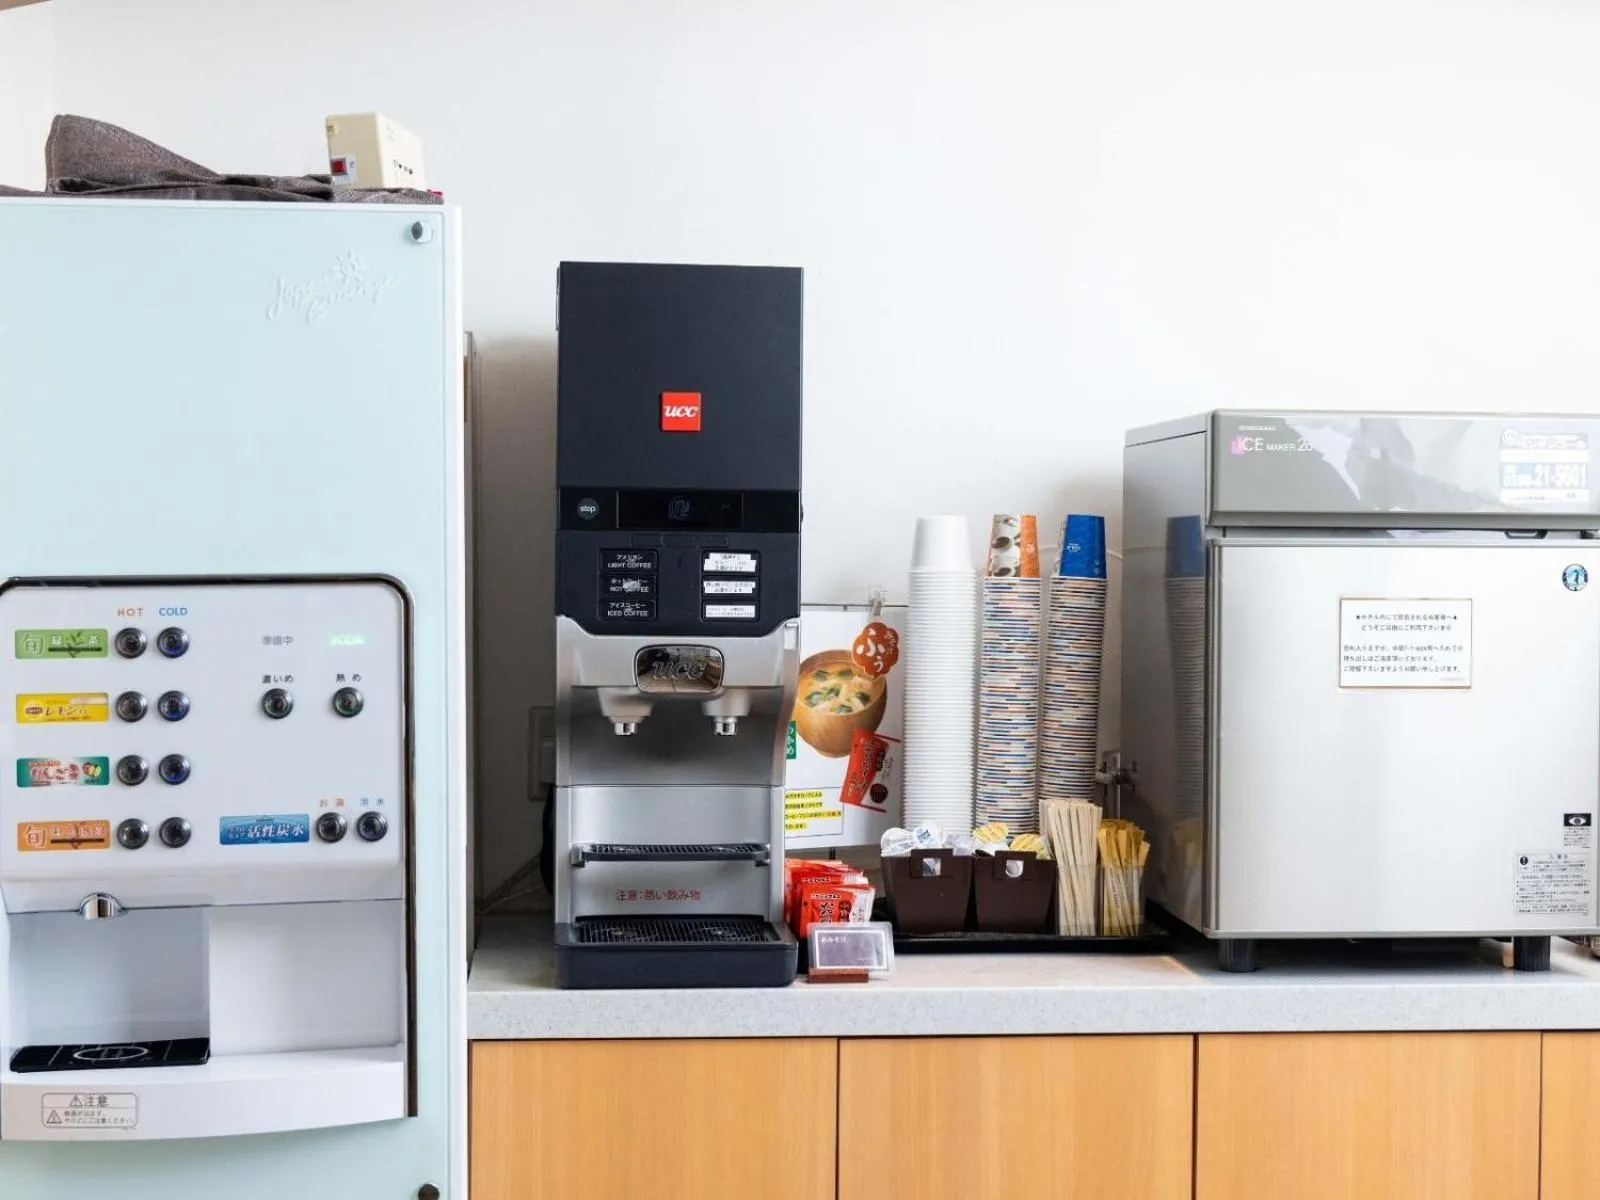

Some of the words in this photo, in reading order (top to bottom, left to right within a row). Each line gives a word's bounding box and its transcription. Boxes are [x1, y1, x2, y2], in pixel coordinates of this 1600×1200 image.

[580, 504, 596, 514] stop
[117, 608, 144, 617] HOT
[159, 607, 188, 617] COLD
